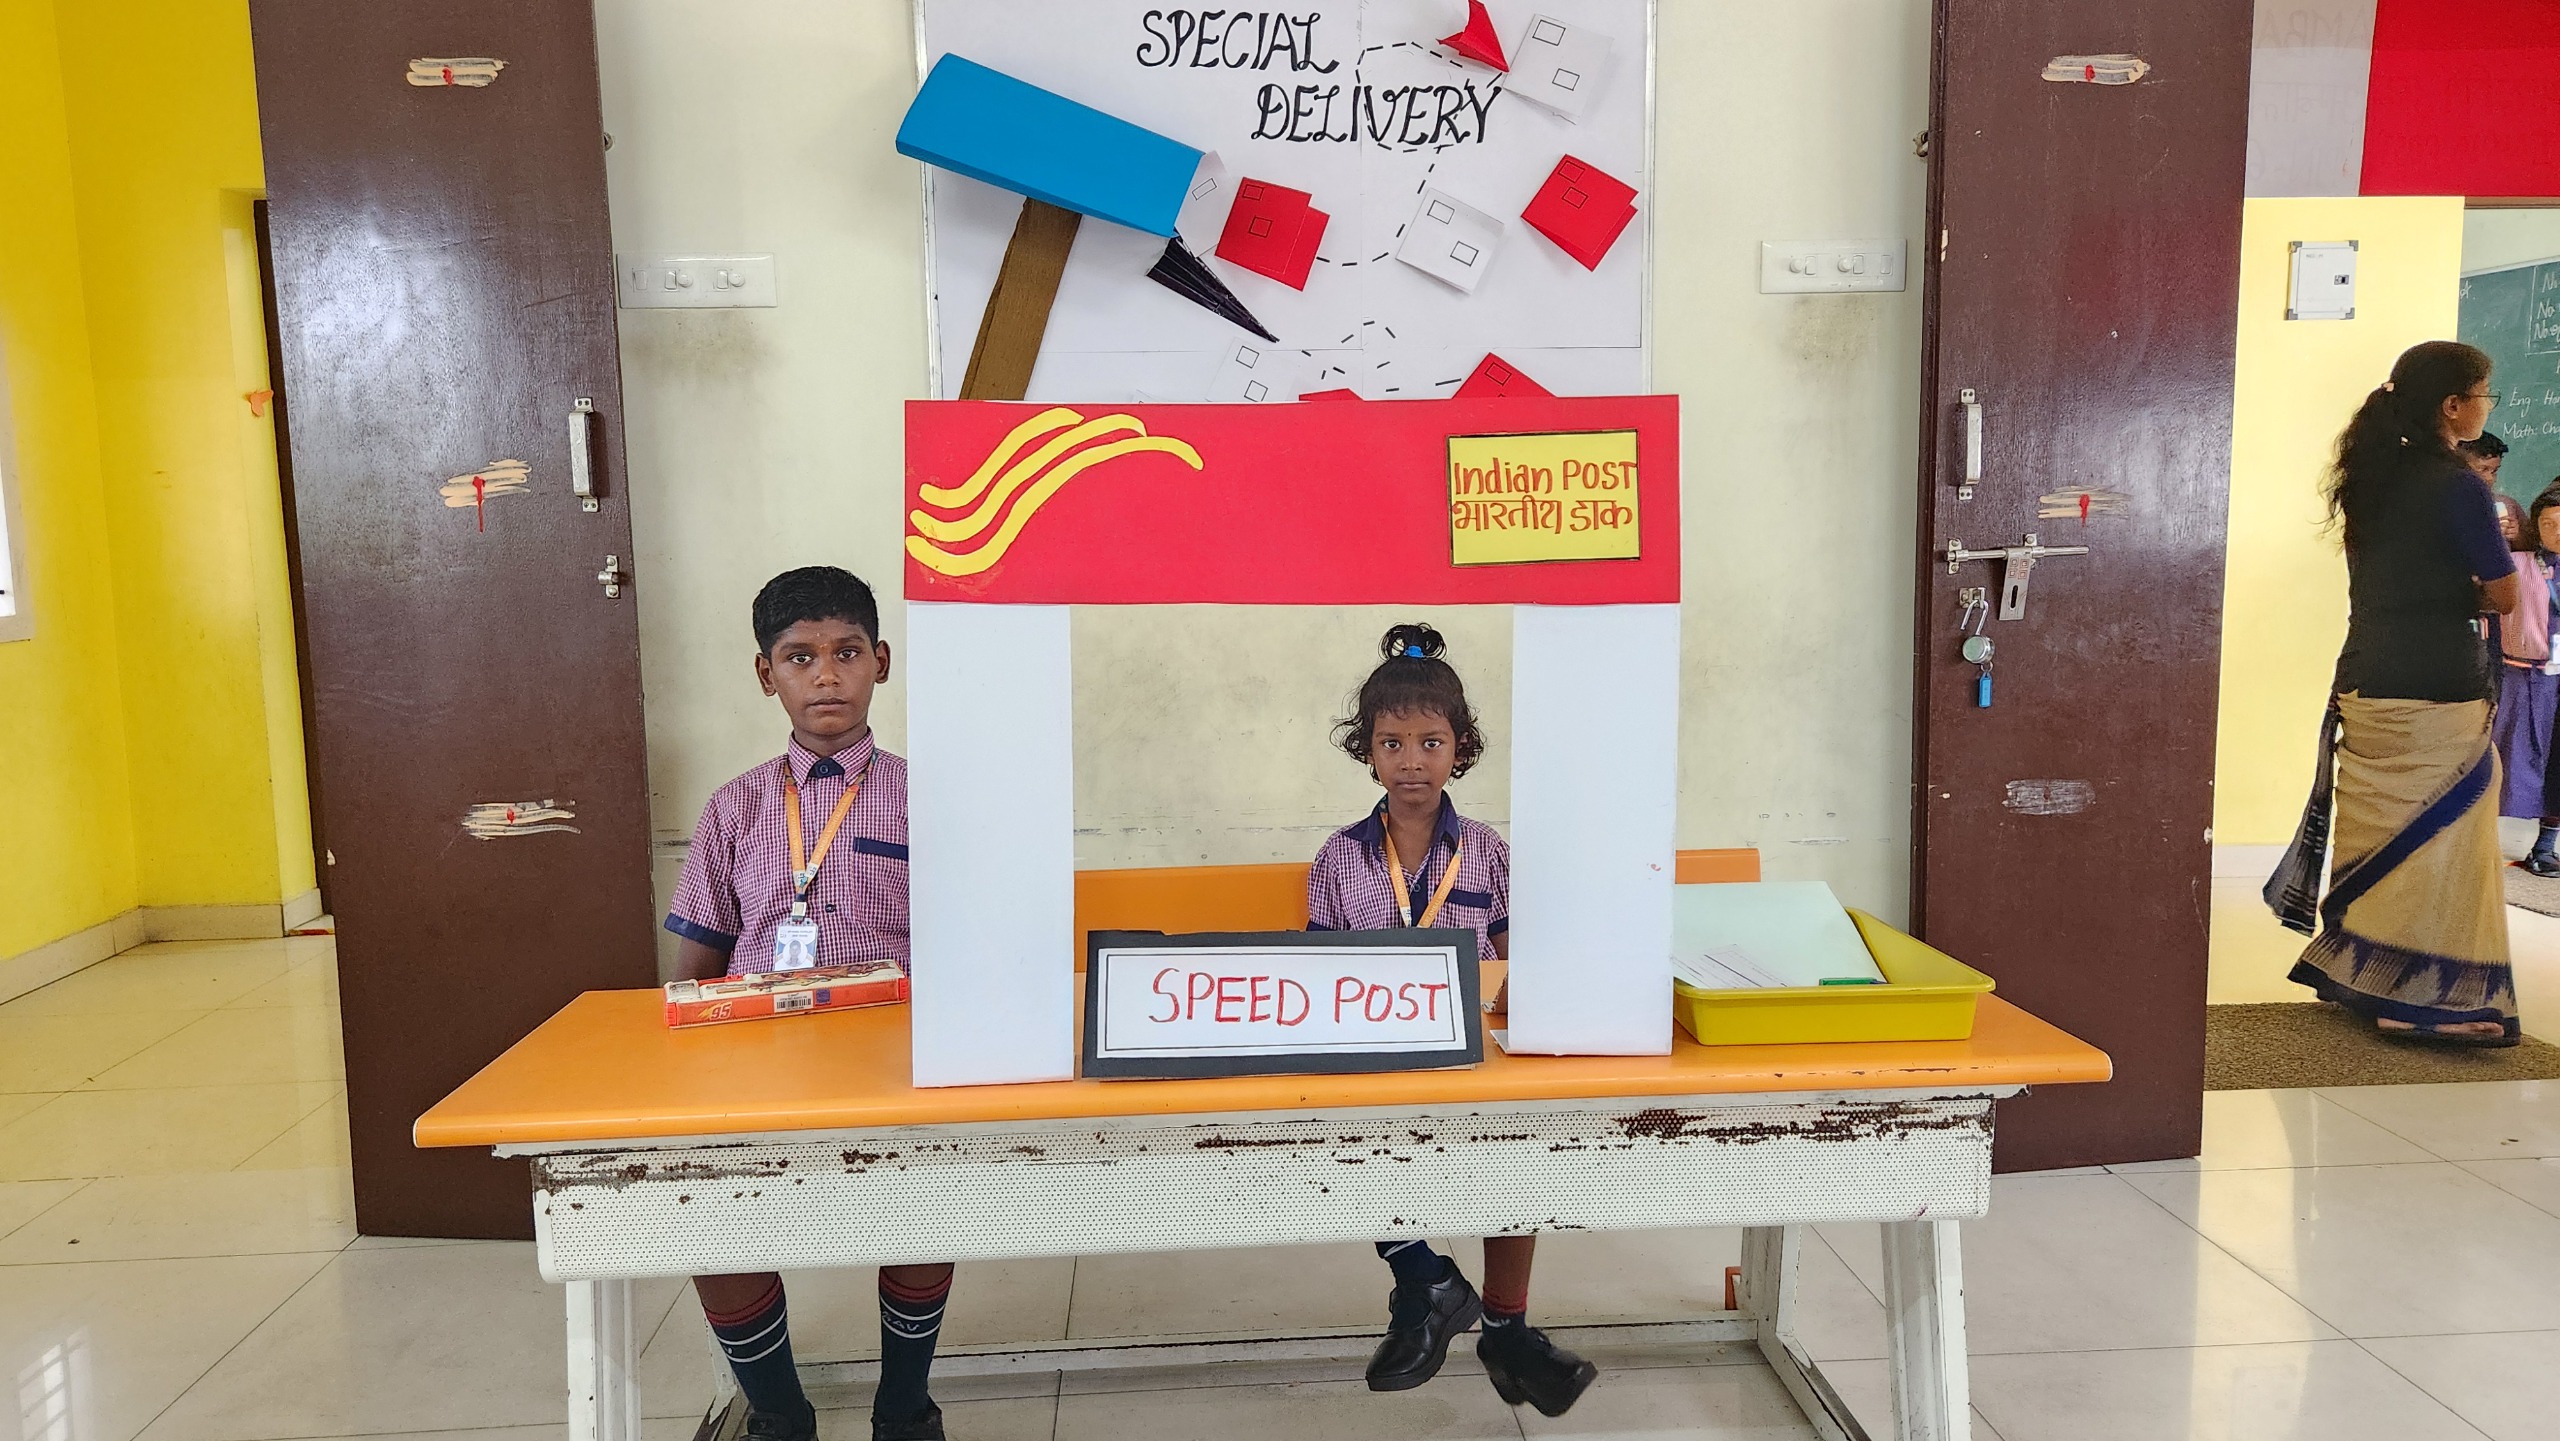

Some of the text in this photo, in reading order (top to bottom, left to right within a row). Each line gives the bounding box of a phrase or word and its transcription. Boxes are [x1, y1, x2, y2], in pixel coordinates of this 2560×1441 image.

[1136, 10, 1340, 74] SPECIAL
[1250, 83, 1502, 146] DELIVERY
[1453, 457, 1637, 495] Indian POST
[1569, 500, 1633, 532] डाक
[710, 1002, 732, 1020] 95
[1148, 967, 1449, 1027] SPEED POST
